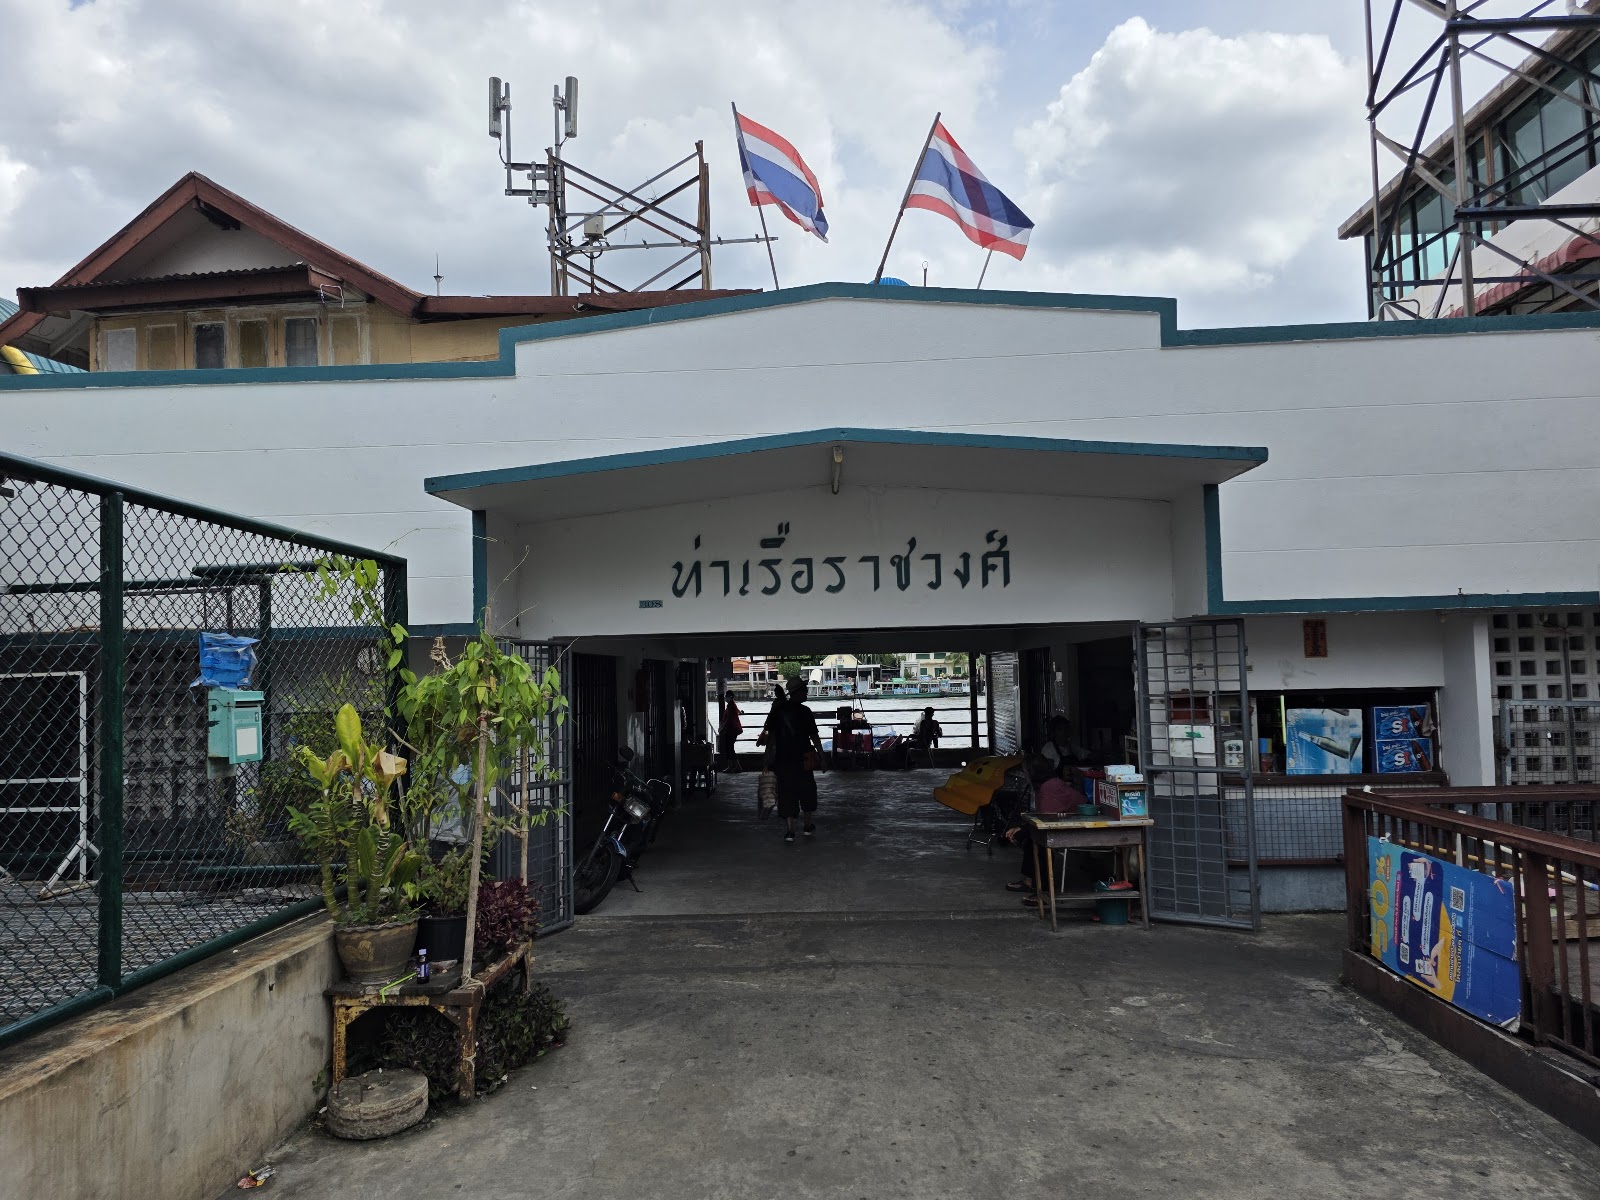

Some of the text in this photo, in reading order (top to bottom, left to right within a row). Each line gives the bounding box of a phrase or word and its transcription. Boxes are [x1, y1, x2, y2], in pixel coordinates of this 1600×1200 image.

[672, 521, 1011, 598] ท่าเรือราชวงศ์
[1380, 717, 1409, 736] est
[1382, 750, 1411, 769] est
